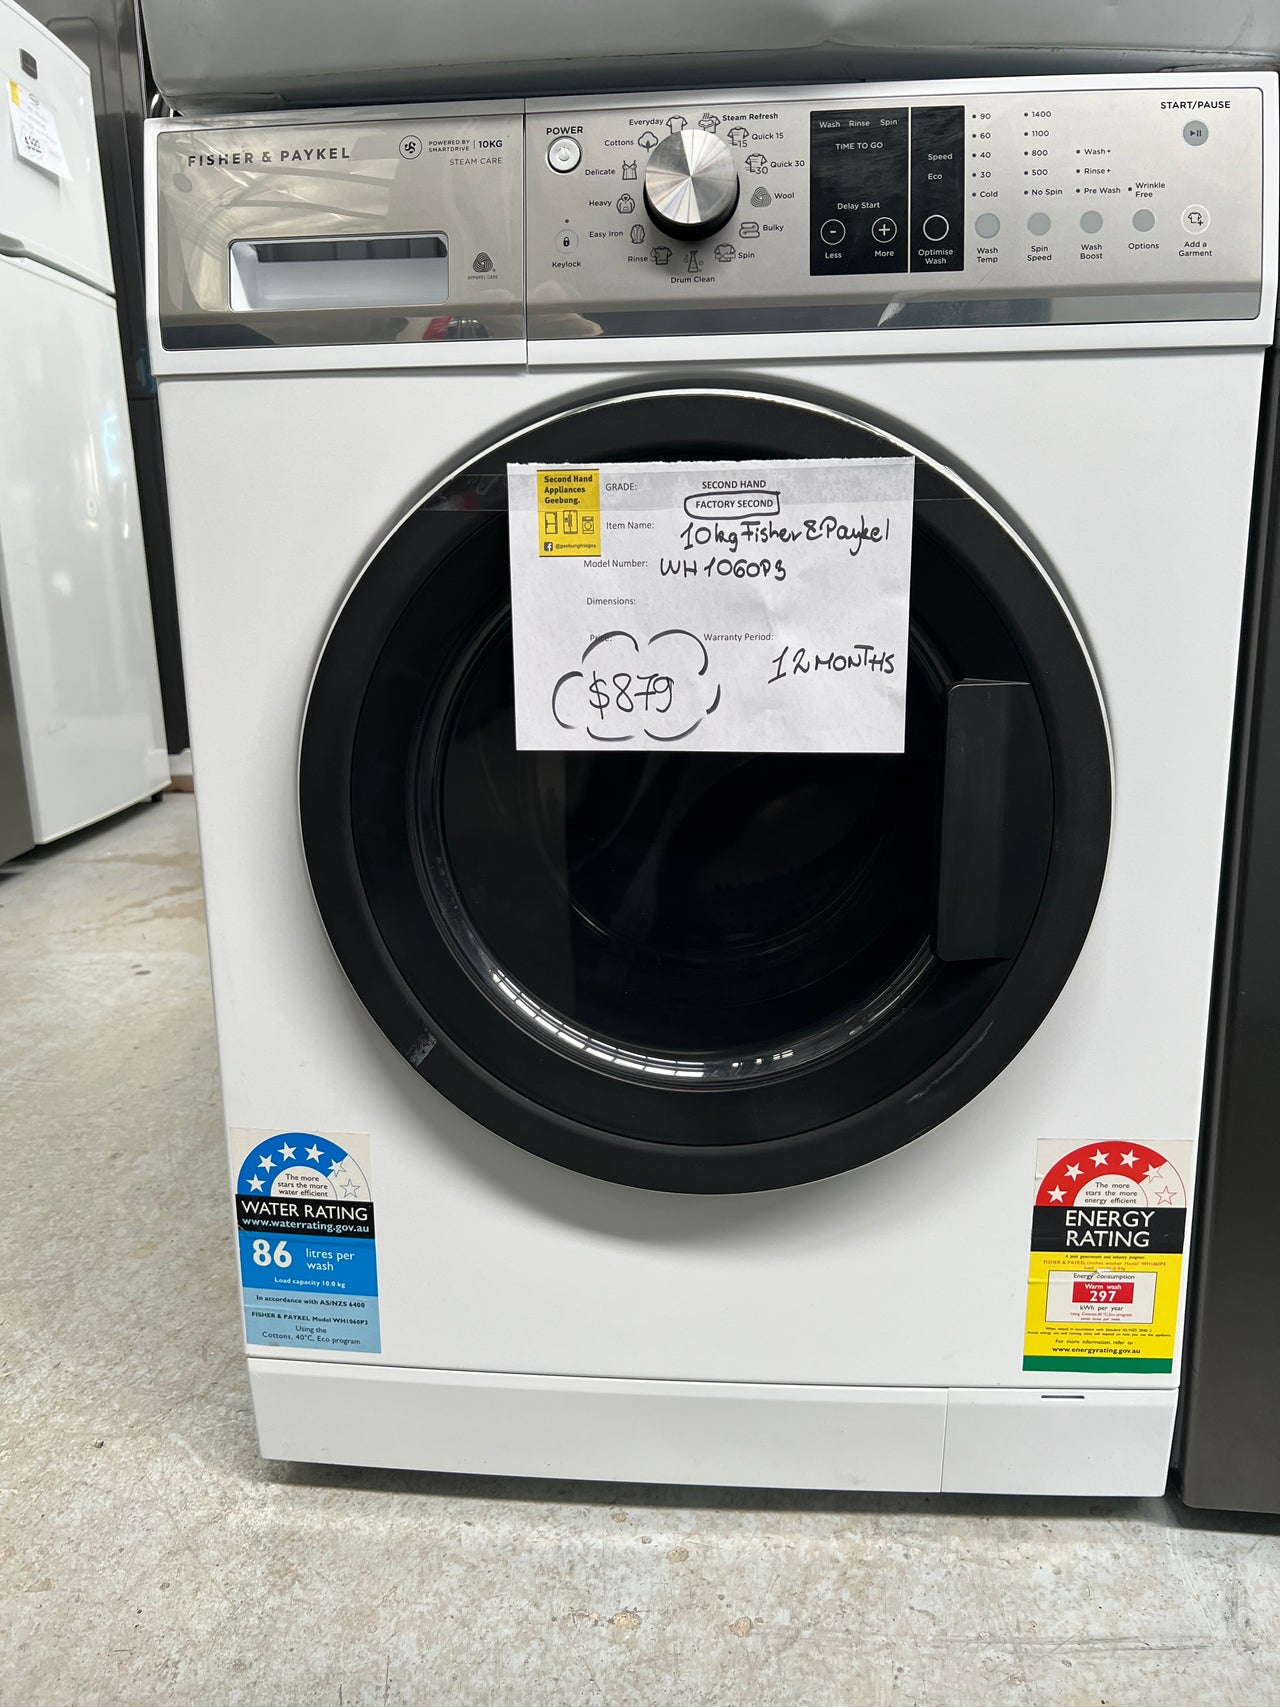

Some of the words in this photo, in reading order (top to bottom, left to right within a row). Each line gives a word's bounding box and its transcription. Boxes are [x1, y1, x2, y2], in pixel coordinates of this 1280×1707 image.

[1161, 100, 1231, 109] START/PAUSE
[722, 114, 745, 122] Steam
[748, 112, 778, 120] Refresh
[629, 118, 663, 127] Everyday
[819, 120, 840, 128] Wash
[849, 119, 870, 127] Rinse
[880, 118, 897, 126] Spin
[546, 126, 584, 135] POWER
[752, 132, 772, 141] Quick
[479, 140, 502, 148] 10KG
[604, 138, 634, 146] Cottons
[738, 140, 748, 148] 15
[857, 142, 868, 150] TO
[188, 151, 254, 167] FISHER
[262, 151, 273, 163] &
[280, 148, 350, 161] PAYKEL
[480, 157, 502, 165] CARE
[928, 153, 953, 161] Speed
[770, 160, 792, 169] Quick
[585, 168, 616, 176] Delicate
[755, 166, 769, 175] 30
[774, 192, 794, 200] Wool
[1045, 188, 1063, 196] Spin
[589, 199, 612, 208] Heavy
[837, 202, 858, 211] Delay
[861, 201, 880, 209] Start
[763, 223, 784, 232] Bulky
[589, 230, 607, 238] Easy
[1031, 245, 1048, 253] Spin
[1081, 243, 1102, 251] Wash
[1128, 242, 1159, 250] Options
[918, 249, 953, 257] Optimise
[628, 255, 648, 263] Rinse
[925, 257, 946, 265] Wash
[1027, 254, 1052, 262] Speed
[552, 260, 581, 269] Keylock
[670, 276, 691, 284] Drum
[692, 275, 715, 283] Clean
[544, 475, 571, 483] Second
[605, 483, 637, 491] GRADE:
[702, 480, 739, 490] SECOND
[742, 479, 766, 489] HAND
[544, 487, 585, 495] Appliances
[545, 497, 580, 505] Geebung.
[695, 500, 735, 509] FACTORY
[738, 499, 773, 508] SECOND
[606, 520, 623, 530] Item
[626, 520, 654, 530] Name:
[583, 559, 609, 568] Model
[612, 558, 648, 568] Number:
[586, 597, 636, 606] Dimensions:
[704, 632, 742, 643] Warranty
[744, 632, 774, 642] Period:
[769, 646, 809, 683] 12
[589, 670, 675, 720] $879
[285, 1173, 299, 1181] The
[300, 1189, 328, 1197] efficient
[241, 1200, 299, 1217] WATER
[305, 1204, 367, 1221] RATING
[1066, 1210, 1155, 1227] ENERGY
[242, 1217, 369, 1234] www.waterrating.gov.au
[1066, 1230, 1150, 1247] RATING
[253, 1239, 292, 1268] 86
[306, 1248, 333, 1259] litres
[337, 1250, 355, 1261] per
[307, 1261, 334, 1271] wash
[292, 1279, 320, 1287] capacity
[338, 1281, 346, 1289] kg
[265, 1296, 302, 1304] accordance
[1090, 1290, 1116, 1301] 297
[296, 1325, 314, 1333] Using
[332, 1337, 361, 1345] program
